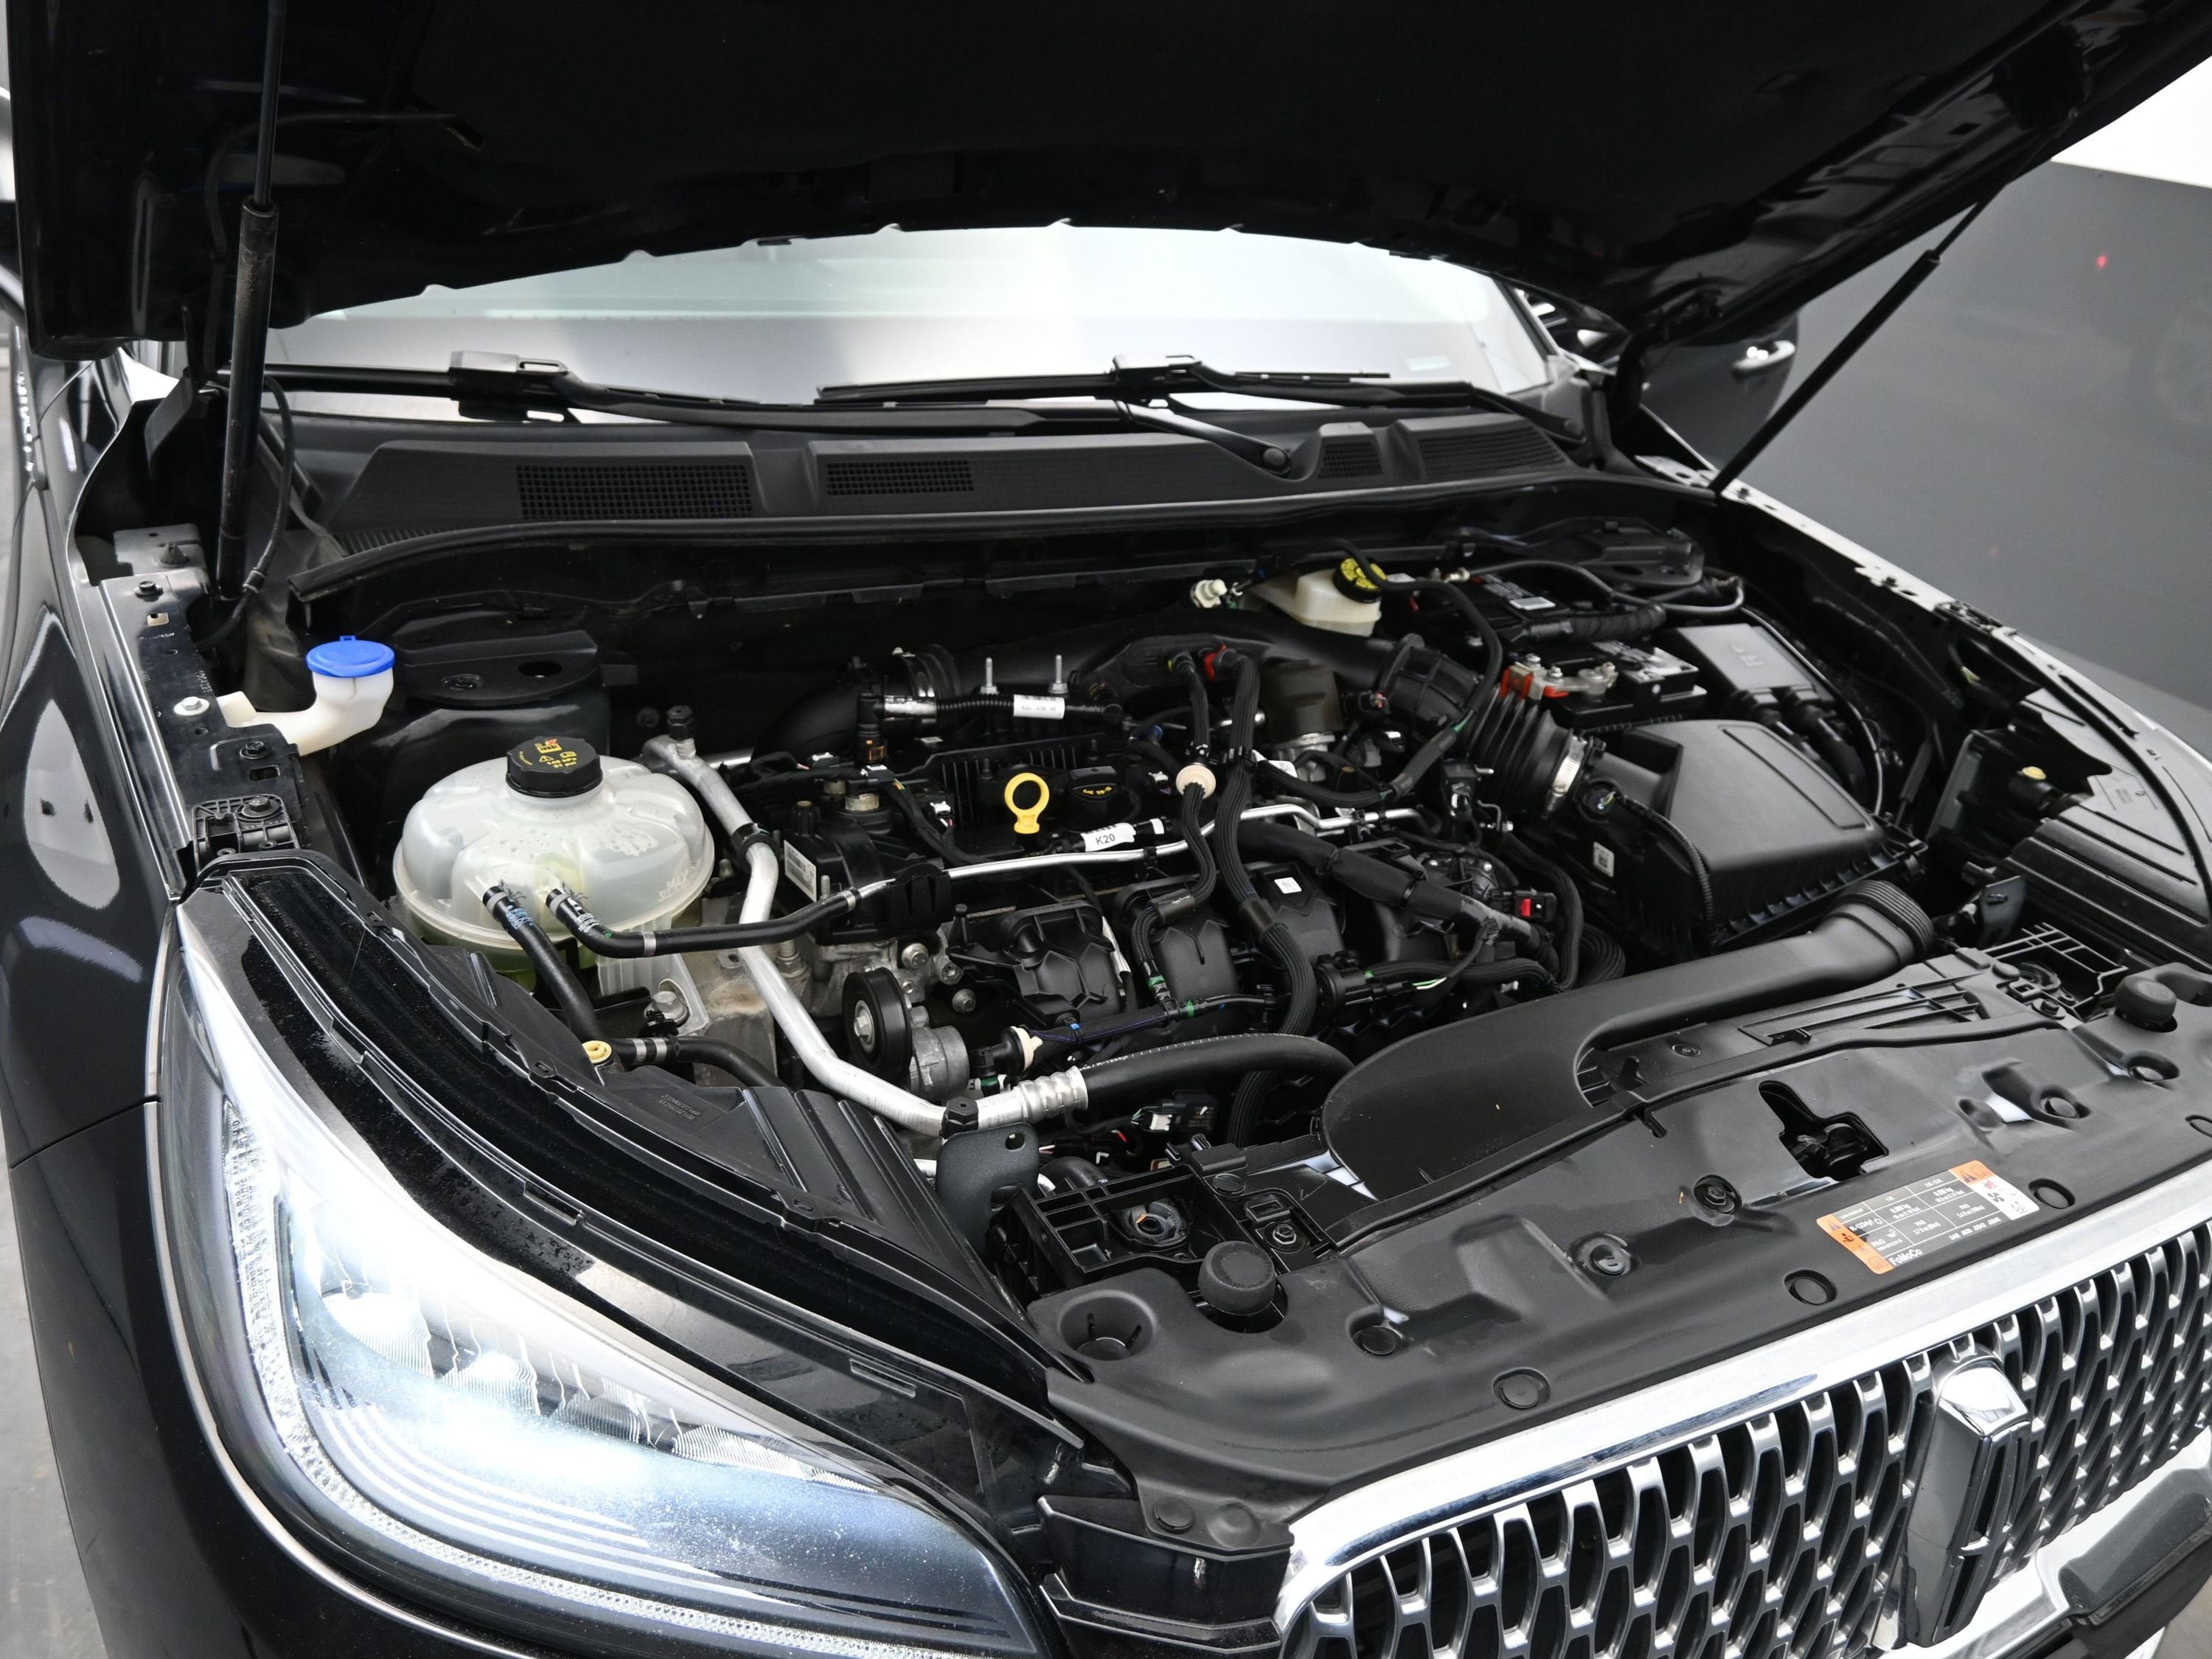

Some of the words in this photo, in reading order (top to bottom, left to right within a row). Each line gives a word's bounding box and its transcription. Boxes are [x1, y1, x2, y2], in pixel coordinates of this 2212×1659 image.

[1095, 833, 1116, 846] K20
[1848, 1219, 1874, 1231] R-1234yf
[1871, 1239, 1886, 1248] PAG
[1888, 1248, 1923, 1266] FoMoCo
